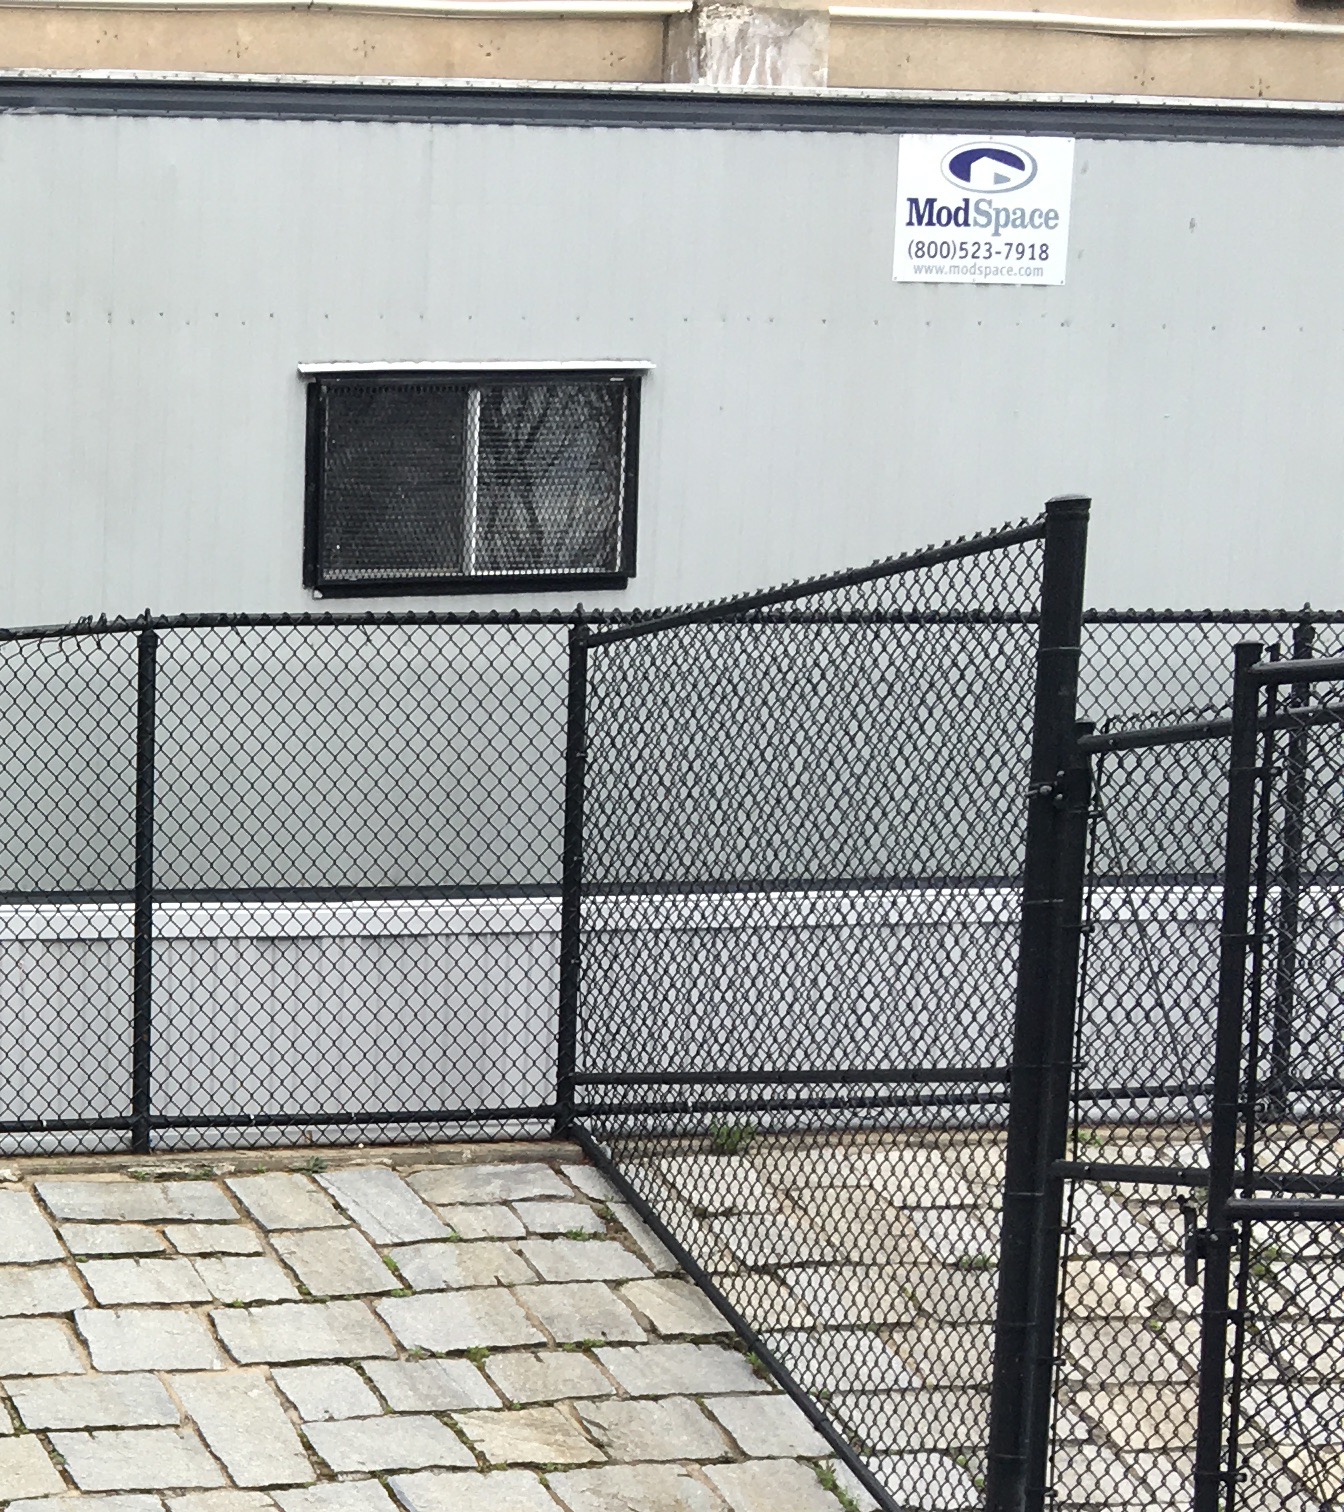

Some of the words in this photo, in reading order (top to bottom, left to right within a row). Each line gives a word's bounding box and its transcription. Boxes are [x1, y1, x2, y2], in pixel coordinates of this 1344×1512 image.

[905, 197, 1060, 237] ModSpace
[908, 240, 1050, 261] (800)523-7918
[913, 262, 1044, 279] www.modspace.com
